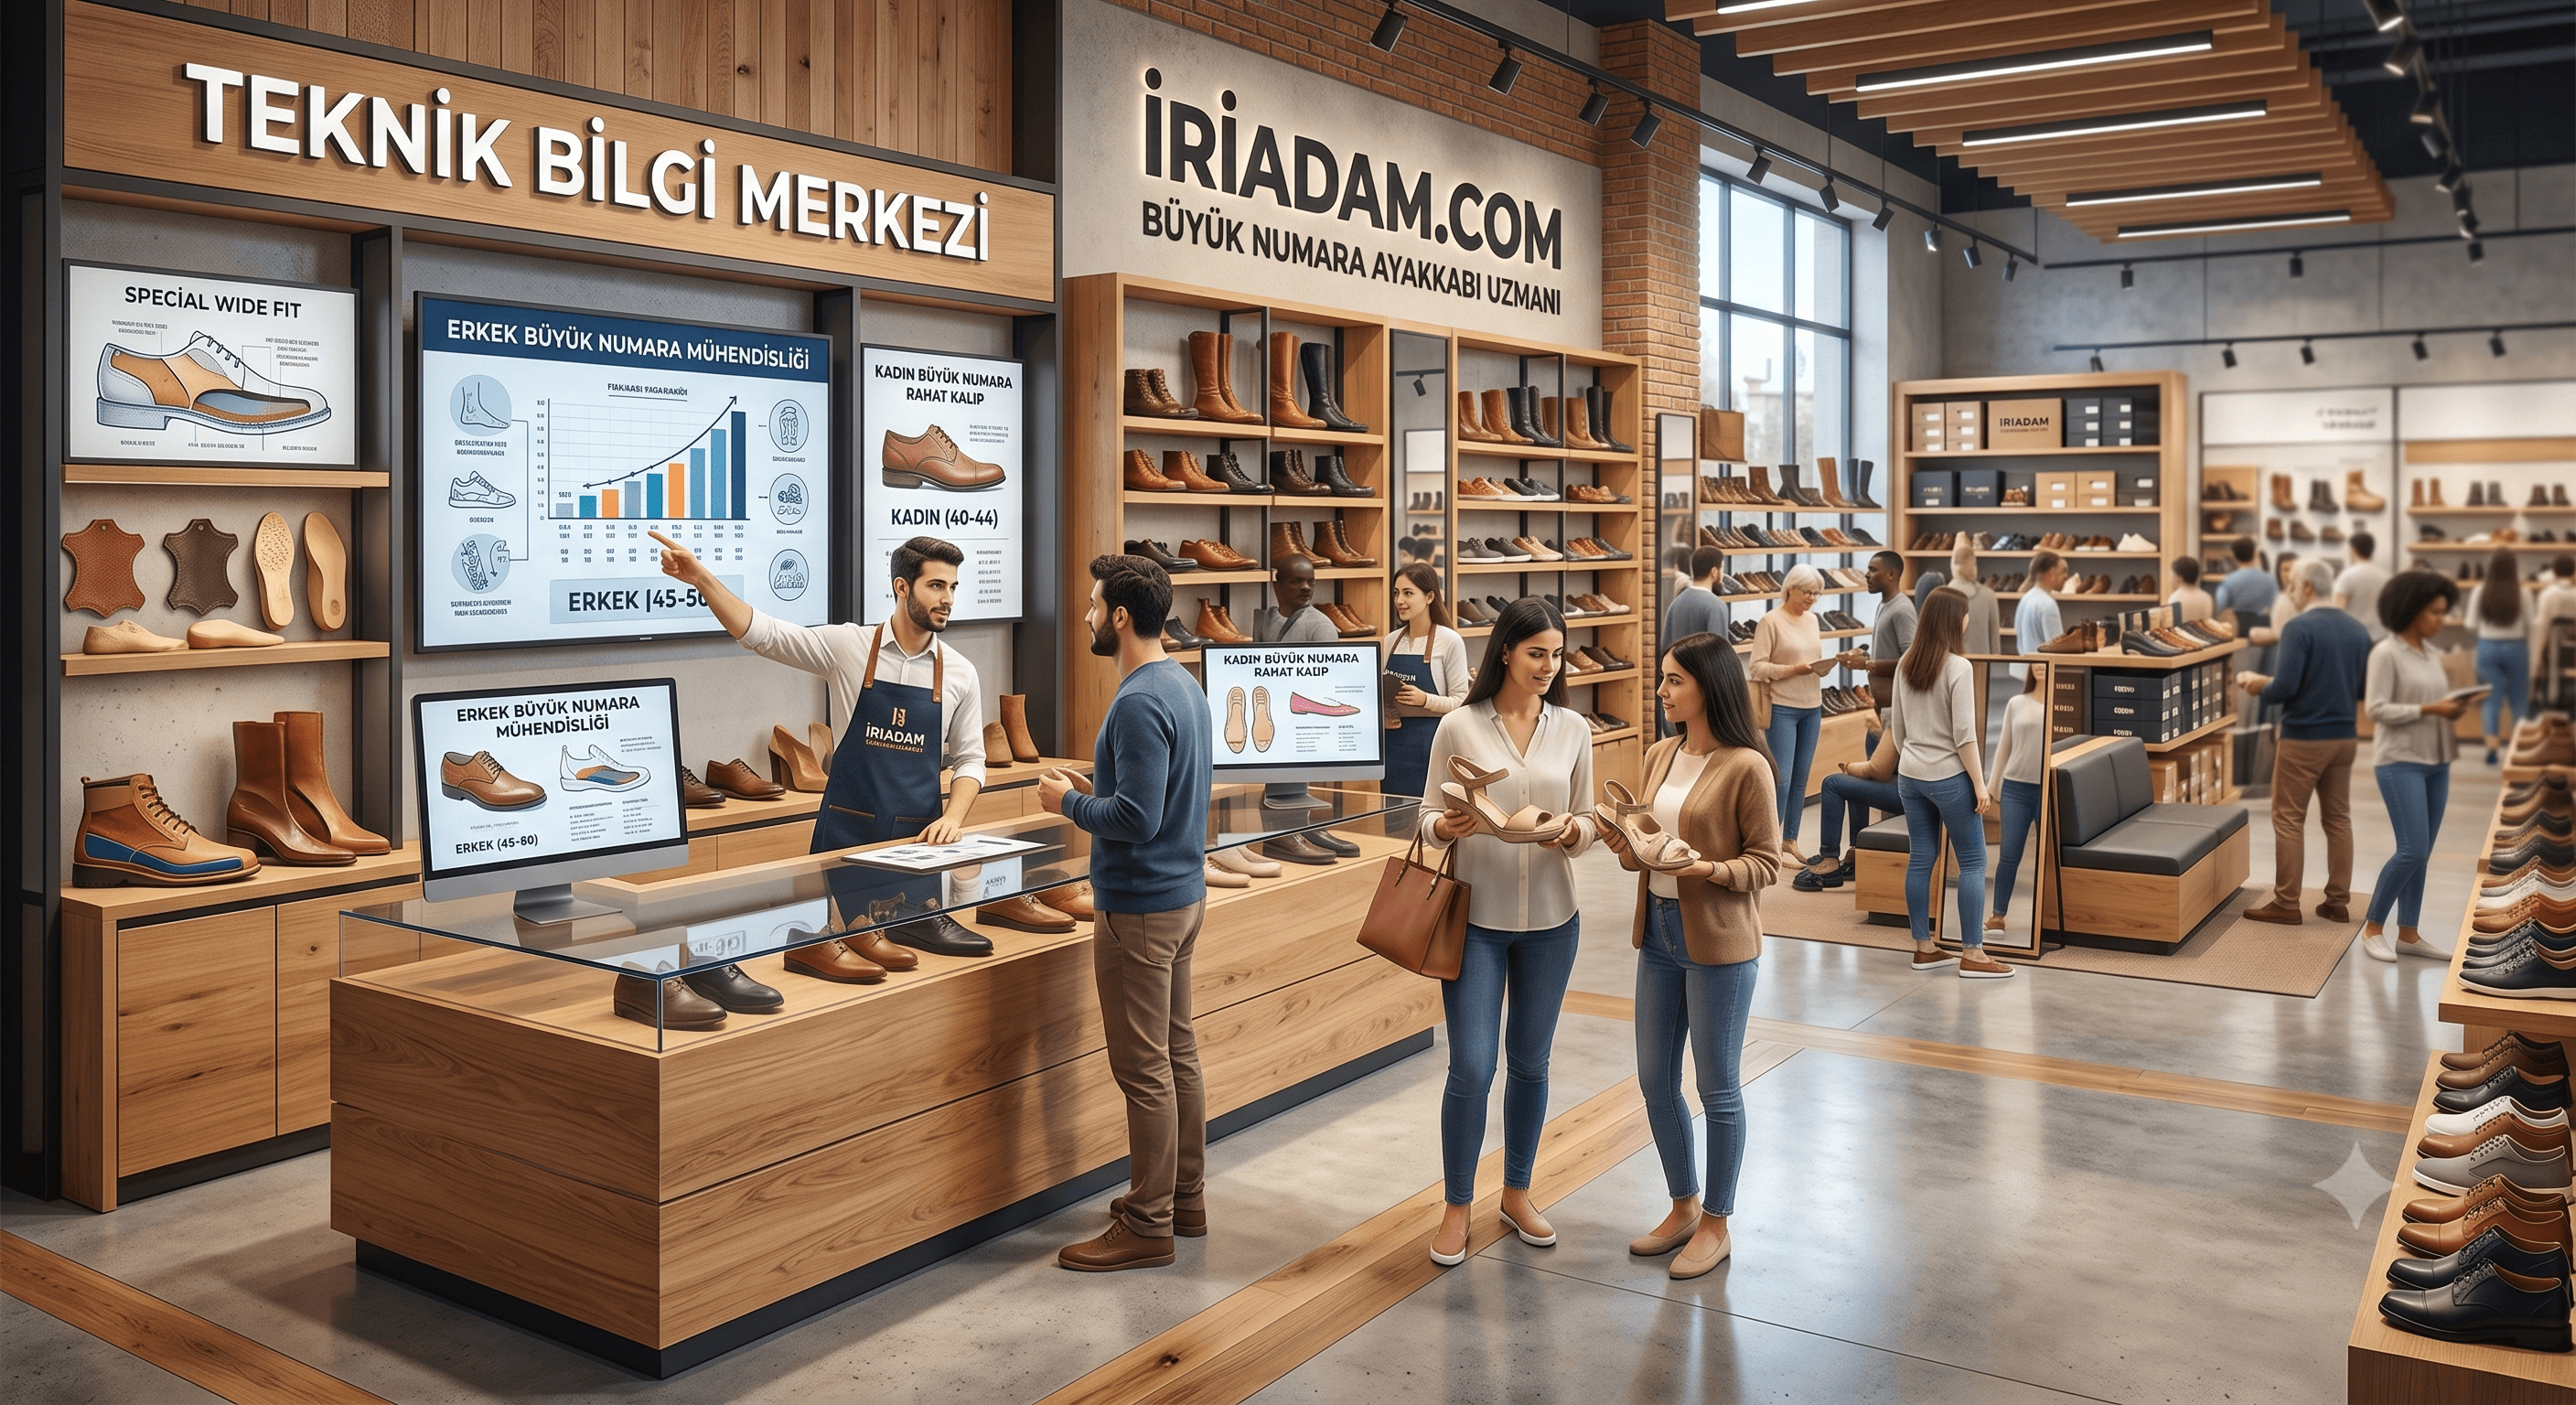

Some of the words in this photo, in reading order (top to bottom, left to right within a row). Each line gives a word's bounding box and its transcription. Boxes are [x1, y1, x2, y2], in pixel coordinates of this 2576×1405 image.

[186, 62, 513, 188] TEKNİK
[539, 116, 716, 219] BİLGİ
[737, 163, 990, 262] MERKEZİ
[1144, 68, 1562, 270] İRİADAM.COM
[1143, 197, 1245, 254] BÜYÜK
[1252, 223, 1367, 278] NUMARA
[1370, 252, 1481, 300] AYAKKABI
[1487, 274, 1561, 316] UZMANI
[214, 295, 268, 316] WIDE
[274, 300, 302, 318] FIT
[447, 318, 519, 345] ERKEK
[524, 323, 594, 351] BÜYÜK
[598, 333, 682, 359] NUMARA
[687, 338, 809, 370] MÜHENDİSLİĞİ
[875, 364, 915, 381] KADIN
[918, 366, 960, 385] BÜYÜK
[962, 372, 1013, 390] NUMARA
[907, 387, 948, 402] RAHAT
[950, 391, 984, 405] KALIP
[2000, 416, 2049, 427] IRIADAM
[891, 509, 940, 526] KADIN
[945, 508, 998, 530] (40-44)
[569, 590, 639, 612] ERKEK
[1224, 654, 1261, 665] KADIN
[1264, 651, 1304, 664] BÜYÜK
[1307, 653, 1359, 664] NUMARA
[456, 705, 510, 723] ERKEK
[514, 699, 568, 718] BÜYÜK
[572, 695, 640, 713] NUMARA
[456, 840, 494, 854] ERKEK
